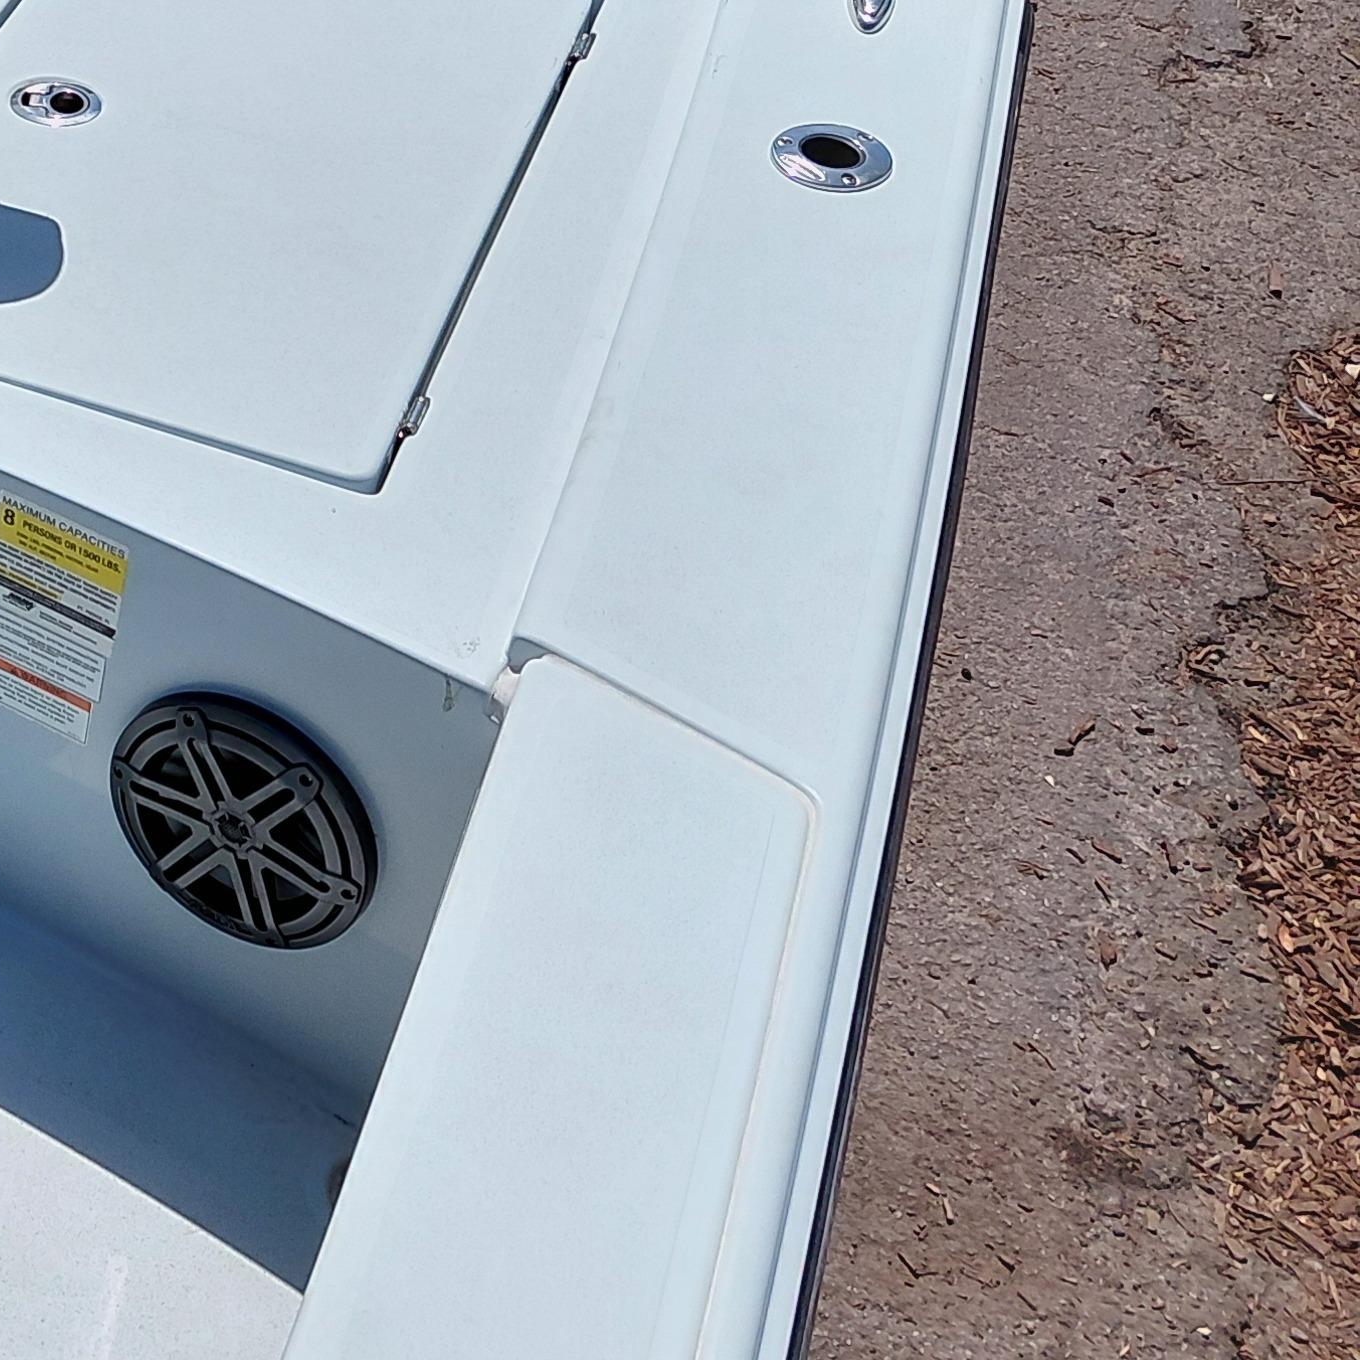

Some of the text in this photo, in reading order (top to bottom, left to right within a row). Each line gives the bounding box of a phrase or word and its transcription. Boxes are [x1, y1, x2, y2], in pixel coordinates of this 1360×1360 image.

[2, 495, 56, 526] MAXIMUM
[58, 521, 126, 559] CAPACITIES
[3, 508, 15, 526] 8
[22, 520, 63, 545] PERSONS
[78, 546, 101, 563] 1500
